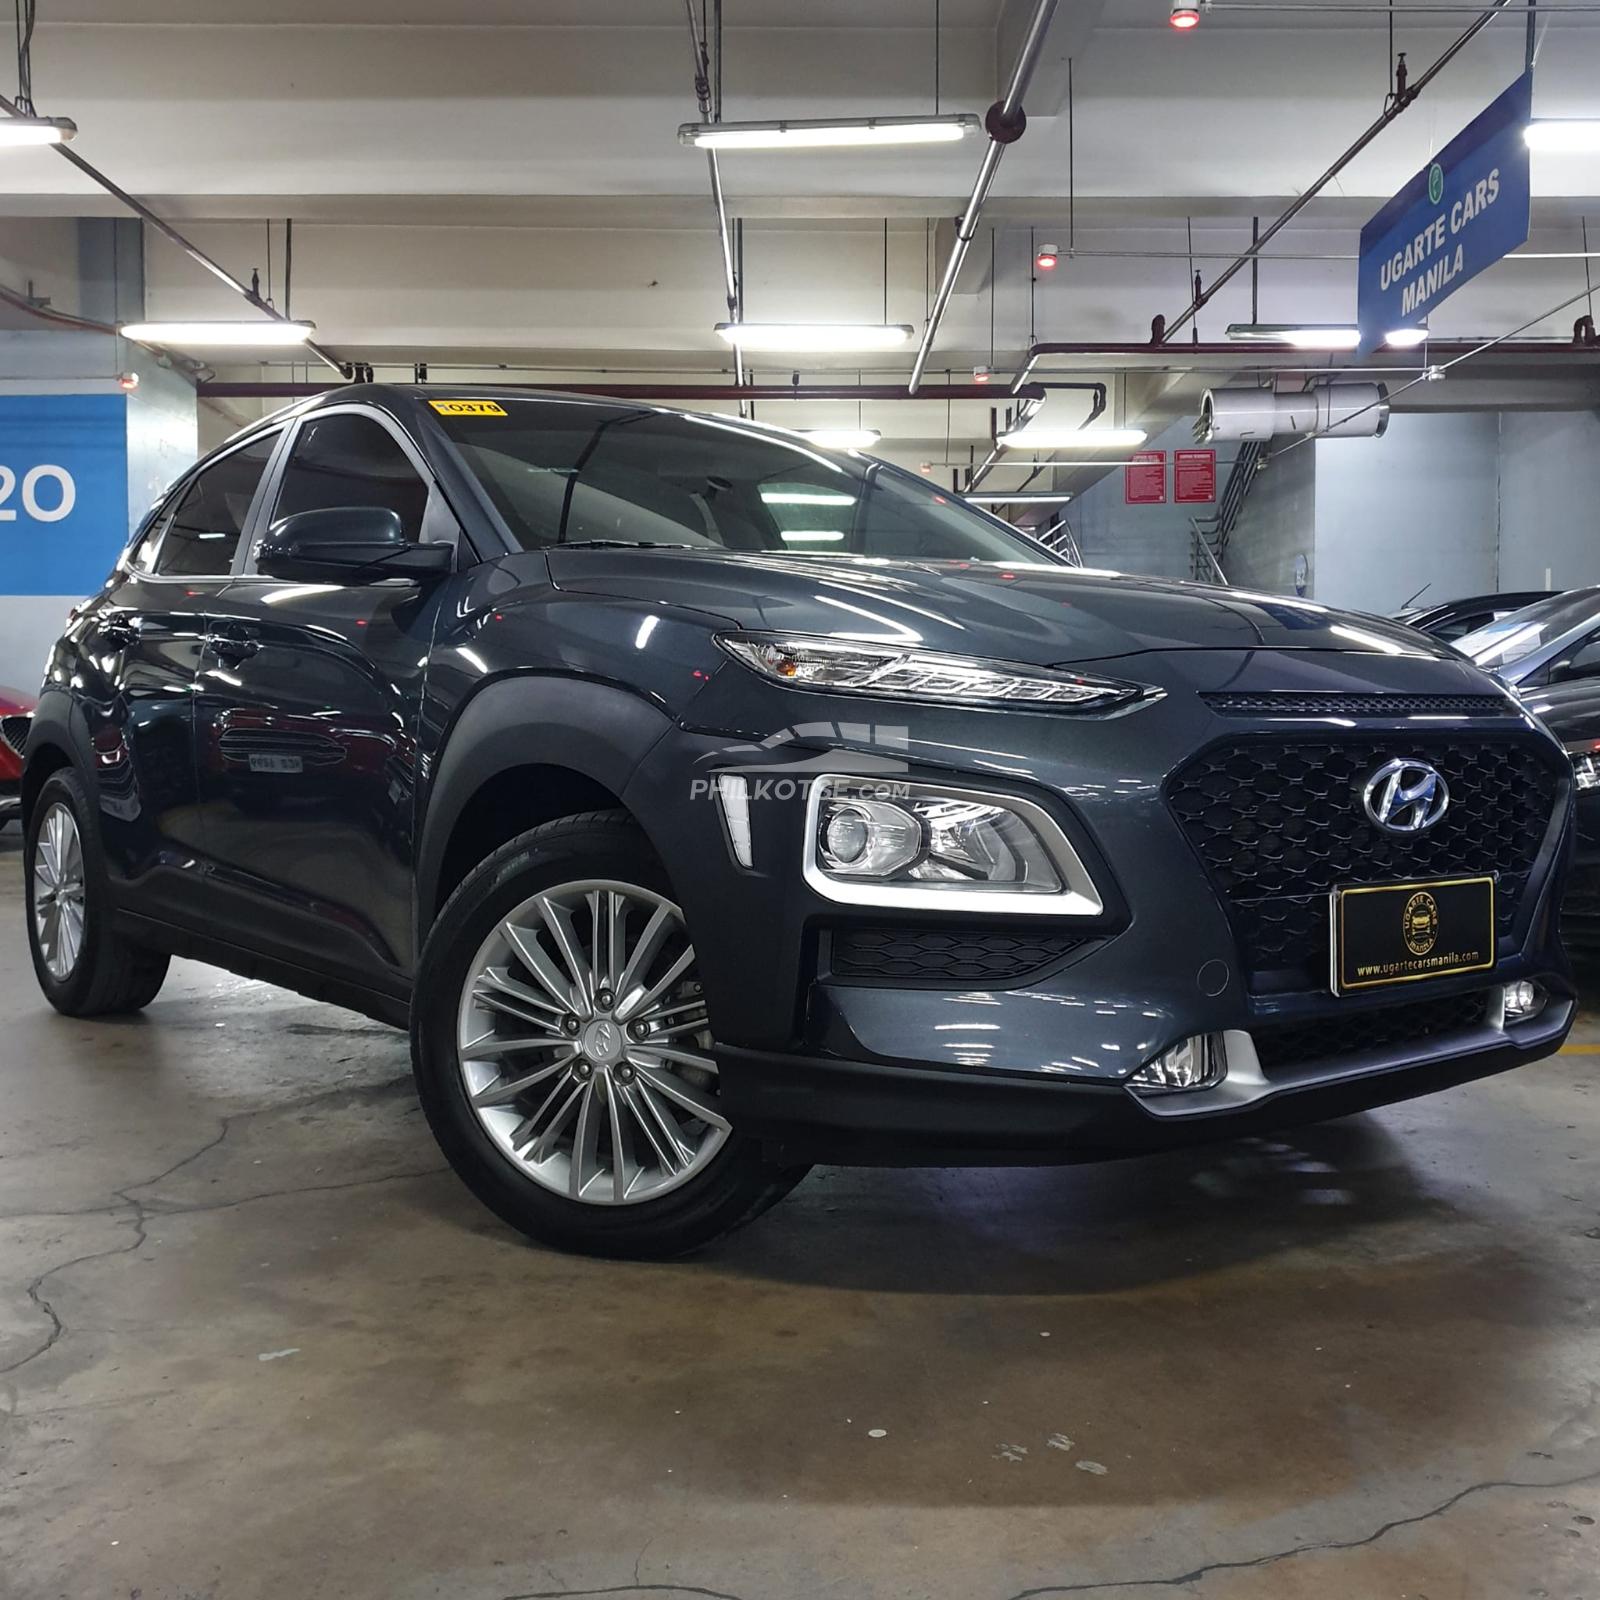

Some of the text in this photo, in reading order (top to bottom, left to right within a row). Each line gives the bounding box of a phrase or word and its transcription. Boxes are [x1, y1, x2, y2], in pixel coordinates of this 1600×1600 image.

[1380, 168, 1500, 291] UGARTE CARS
[1401, 243, 1464, 317] MANILA
[1357, 951, 1480, 977] www.ugartecarsmanila.com
